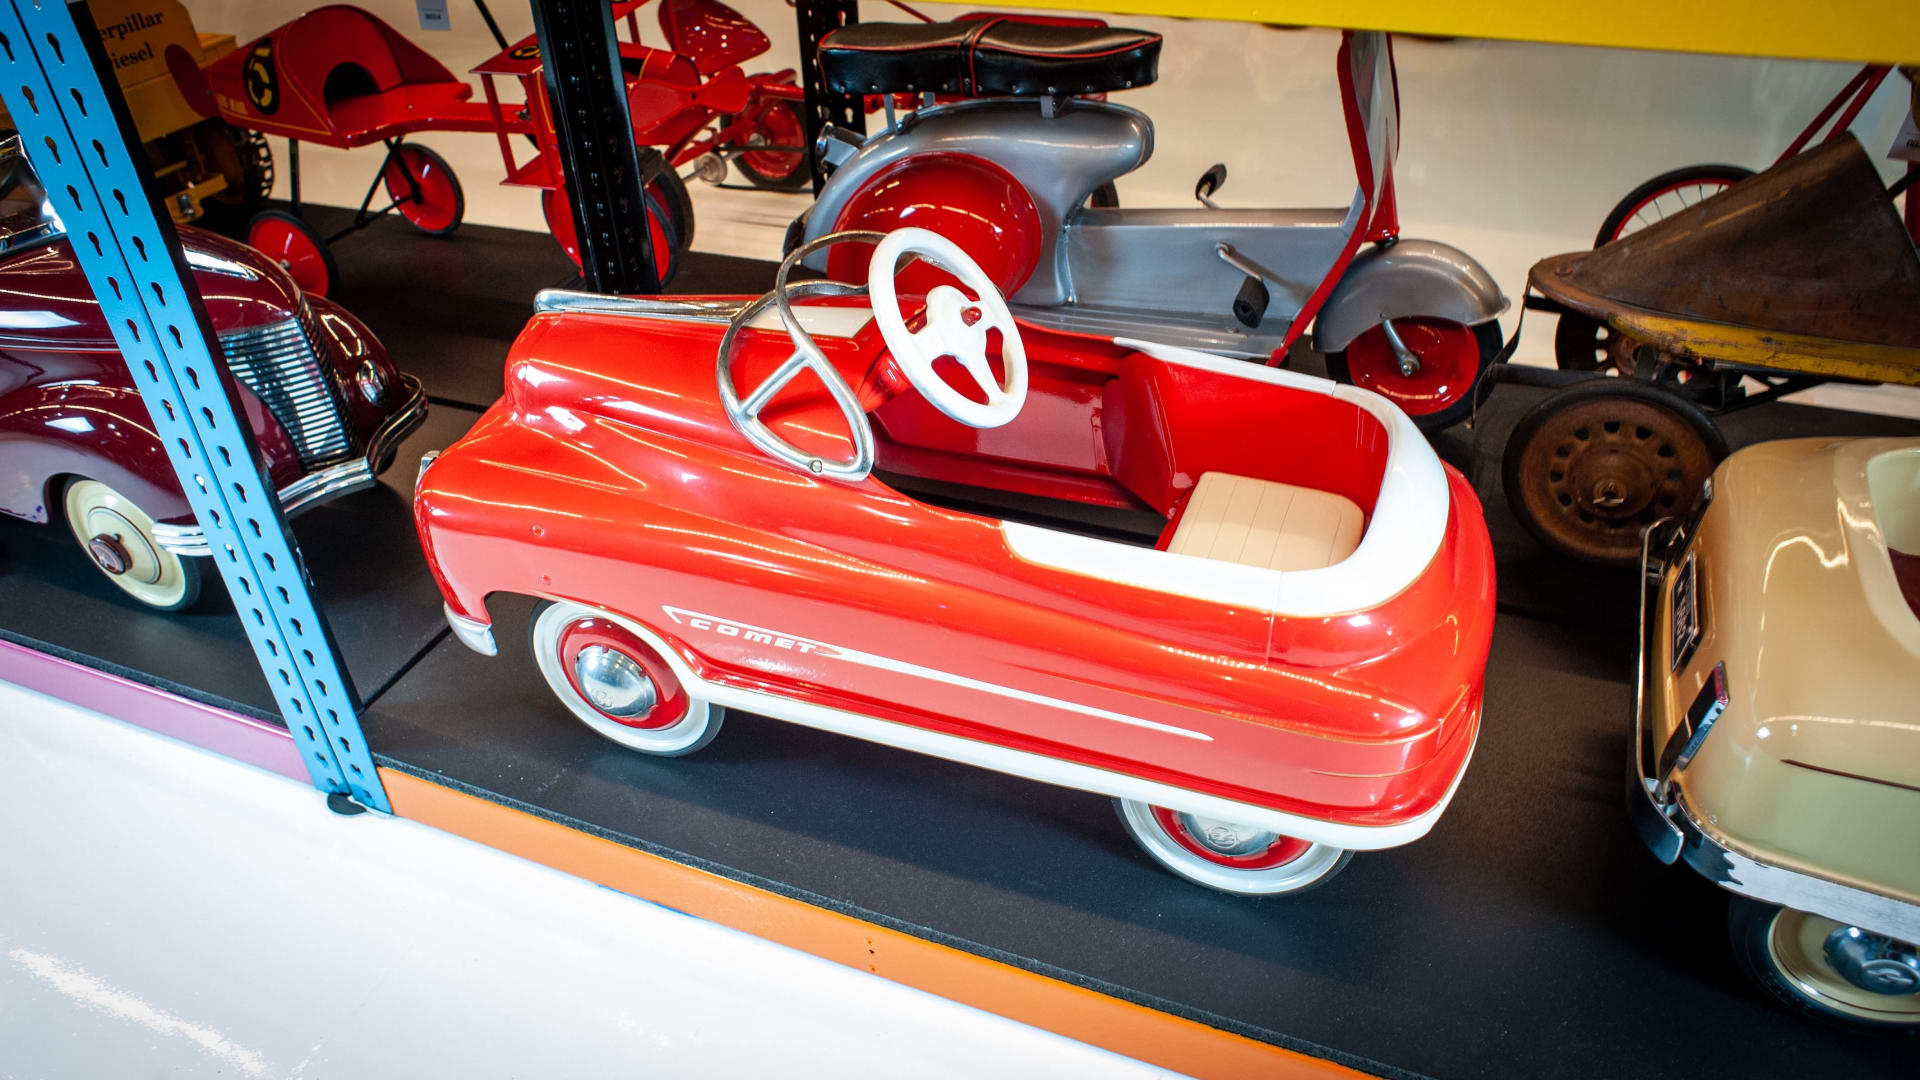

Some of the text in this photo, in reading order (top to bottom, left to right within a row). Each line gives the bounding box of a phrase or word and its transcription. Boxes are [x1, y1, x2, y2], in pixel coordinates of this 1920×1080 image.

[98, 12, 164, 40] erpillar
[111, 42, 155, 69] iesel
[690, 618, 817, 653] COMET
